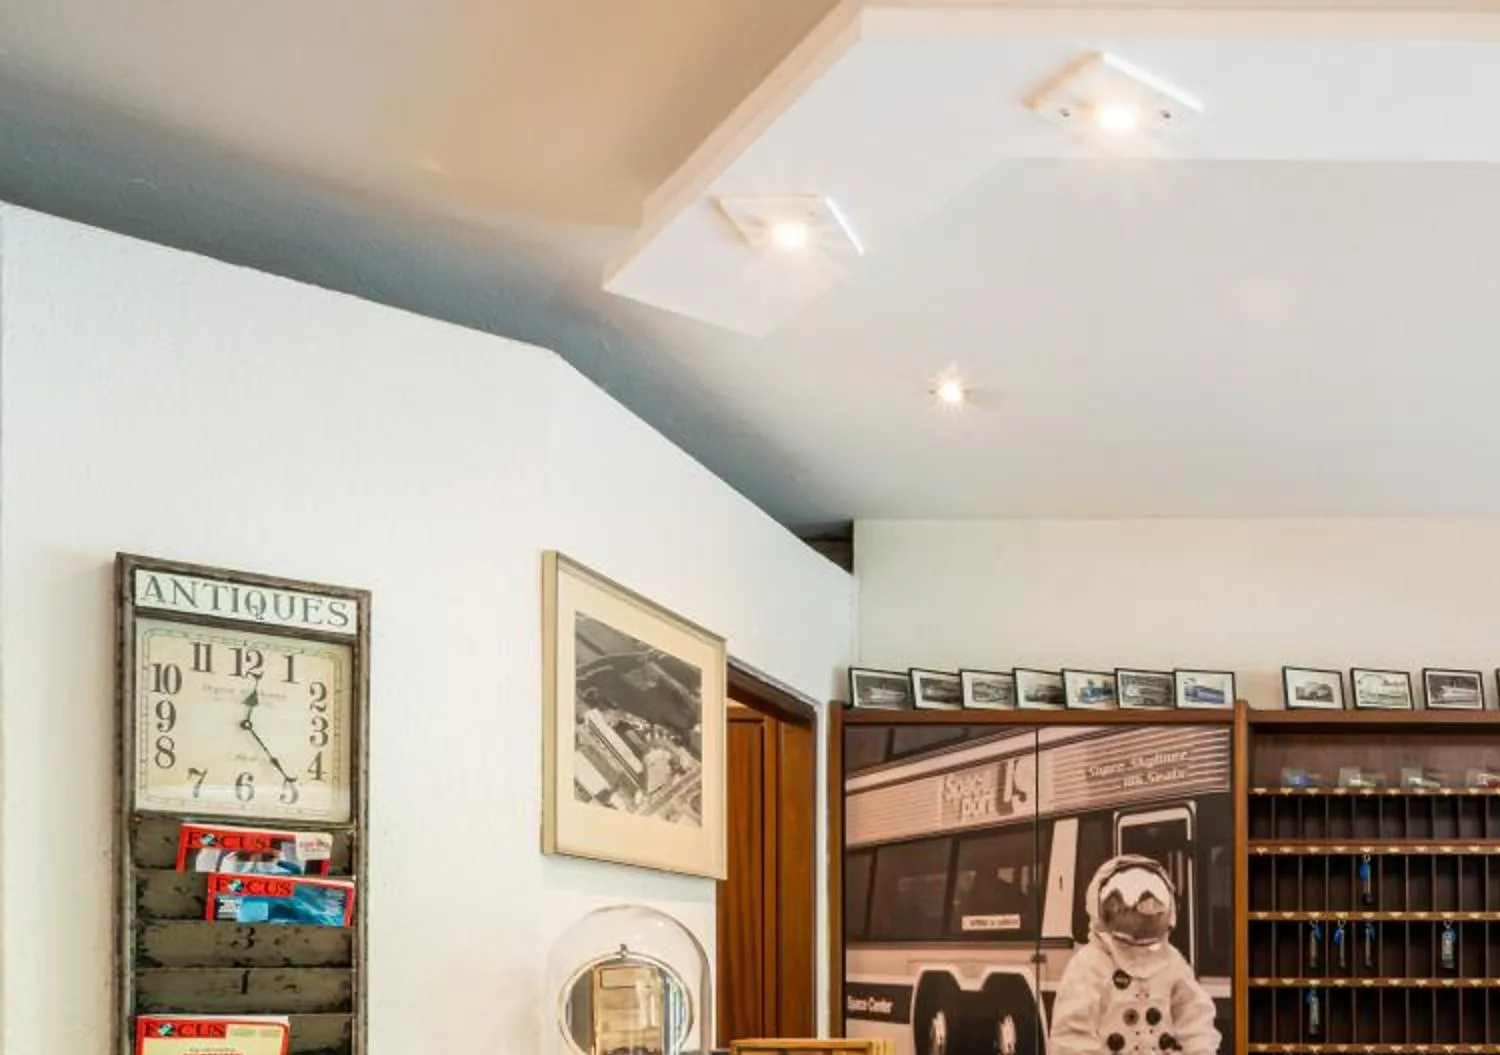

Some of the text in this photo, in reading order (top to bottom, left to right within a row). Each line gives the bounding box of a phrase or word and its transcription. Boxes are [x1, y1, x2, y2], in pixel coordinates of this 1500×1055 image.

[140, 575, 350, 628] ANTIQUES
[190, 642, 215, 673] 11
[228, 648, 264, 680] 12
[282, 655, 299, 684] 1
[151, 663, 182, 695] 10
[309, 682, 327, 713] 2
[156, 700, 176, 732] 9
[309, 716, 329, 747] 3
[155, 736, 176, 769] 8
[307, 751, 327, 782] 4
[187, 767, 208, 798] 7
[235, 772, 255, 802] 6
[280, 777, 299, 804] 5
[188, 831, 269, 850] FOCUS
[217, 877, 293, 896] FOCUS
[144, 1023, 226, 1037] FOCUS
